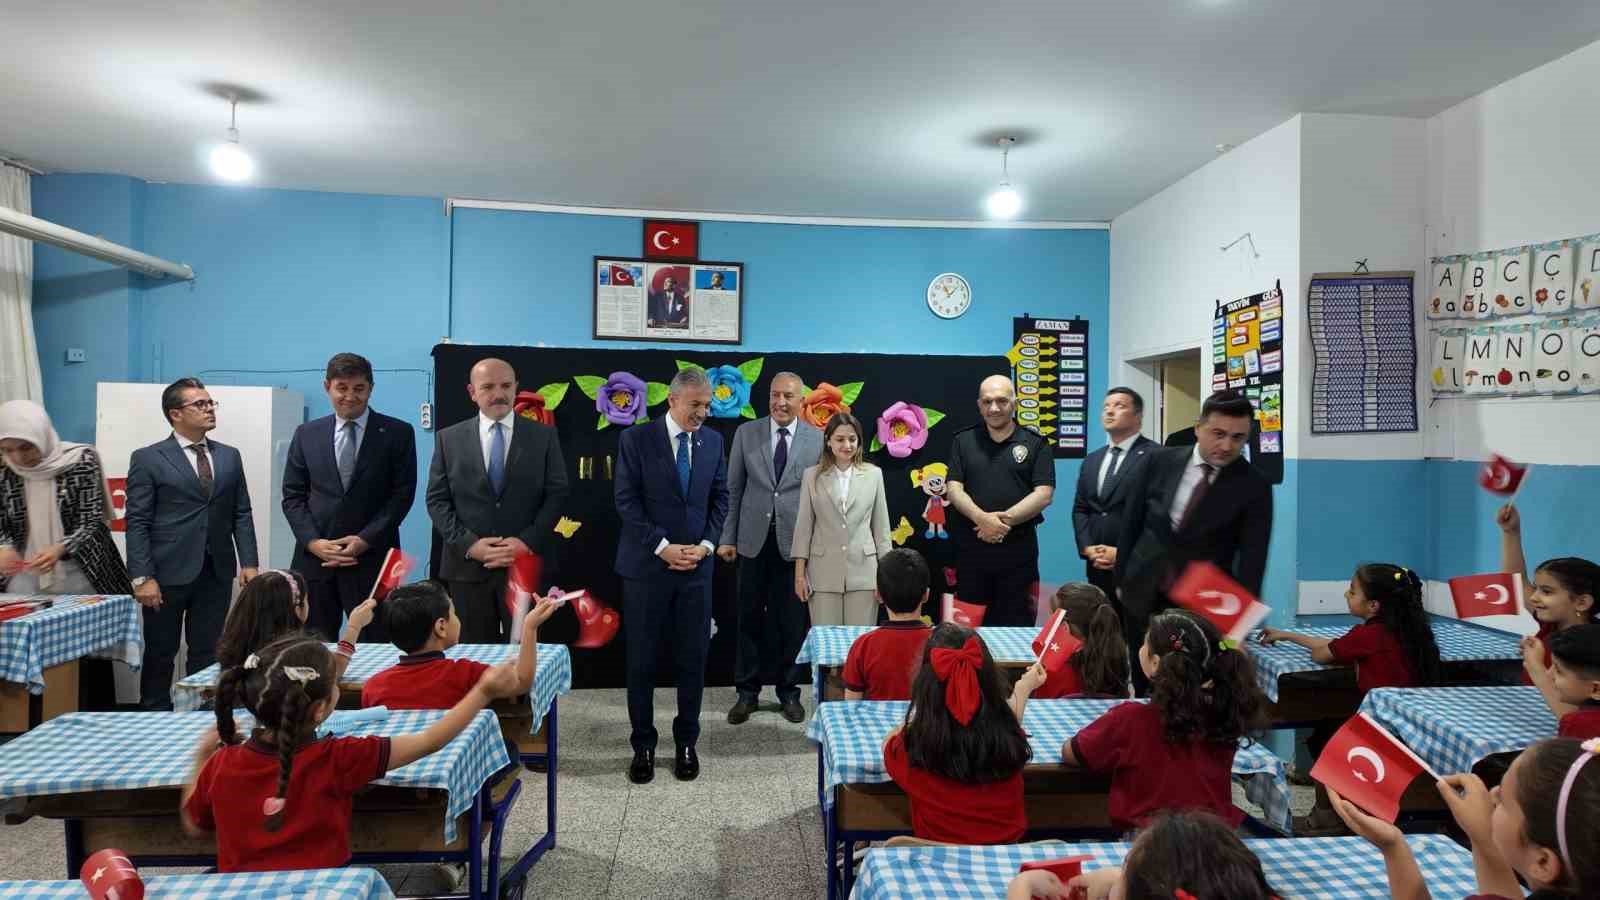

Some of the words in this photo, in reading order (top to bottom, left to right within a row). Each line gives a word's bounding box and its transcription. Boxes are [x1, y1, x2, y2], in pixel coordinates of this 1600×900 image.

[1439, 267, 1453, 287] A
[1473, 267, 1484, 288] B
[1503, 260, 1520, 282] C
[1544, 254, 1561, 280] Ç
[1446, 301, 1455, 312] a
[1478, 293, 1488, 313] b
[1514, 296, 1525, 307] c
[1555, 289, 1566, 305] ç
[1443, 340, 1453, 360] L
[1472, 338, 1490, 359] M
[1506, 336, 1522, 359] N
[1542, 333, 1563, 355] O
[1482, 374, 1496, 386] m
[1519, 371, 1530, 382] n
[1558, 370, 1570, 382] o
